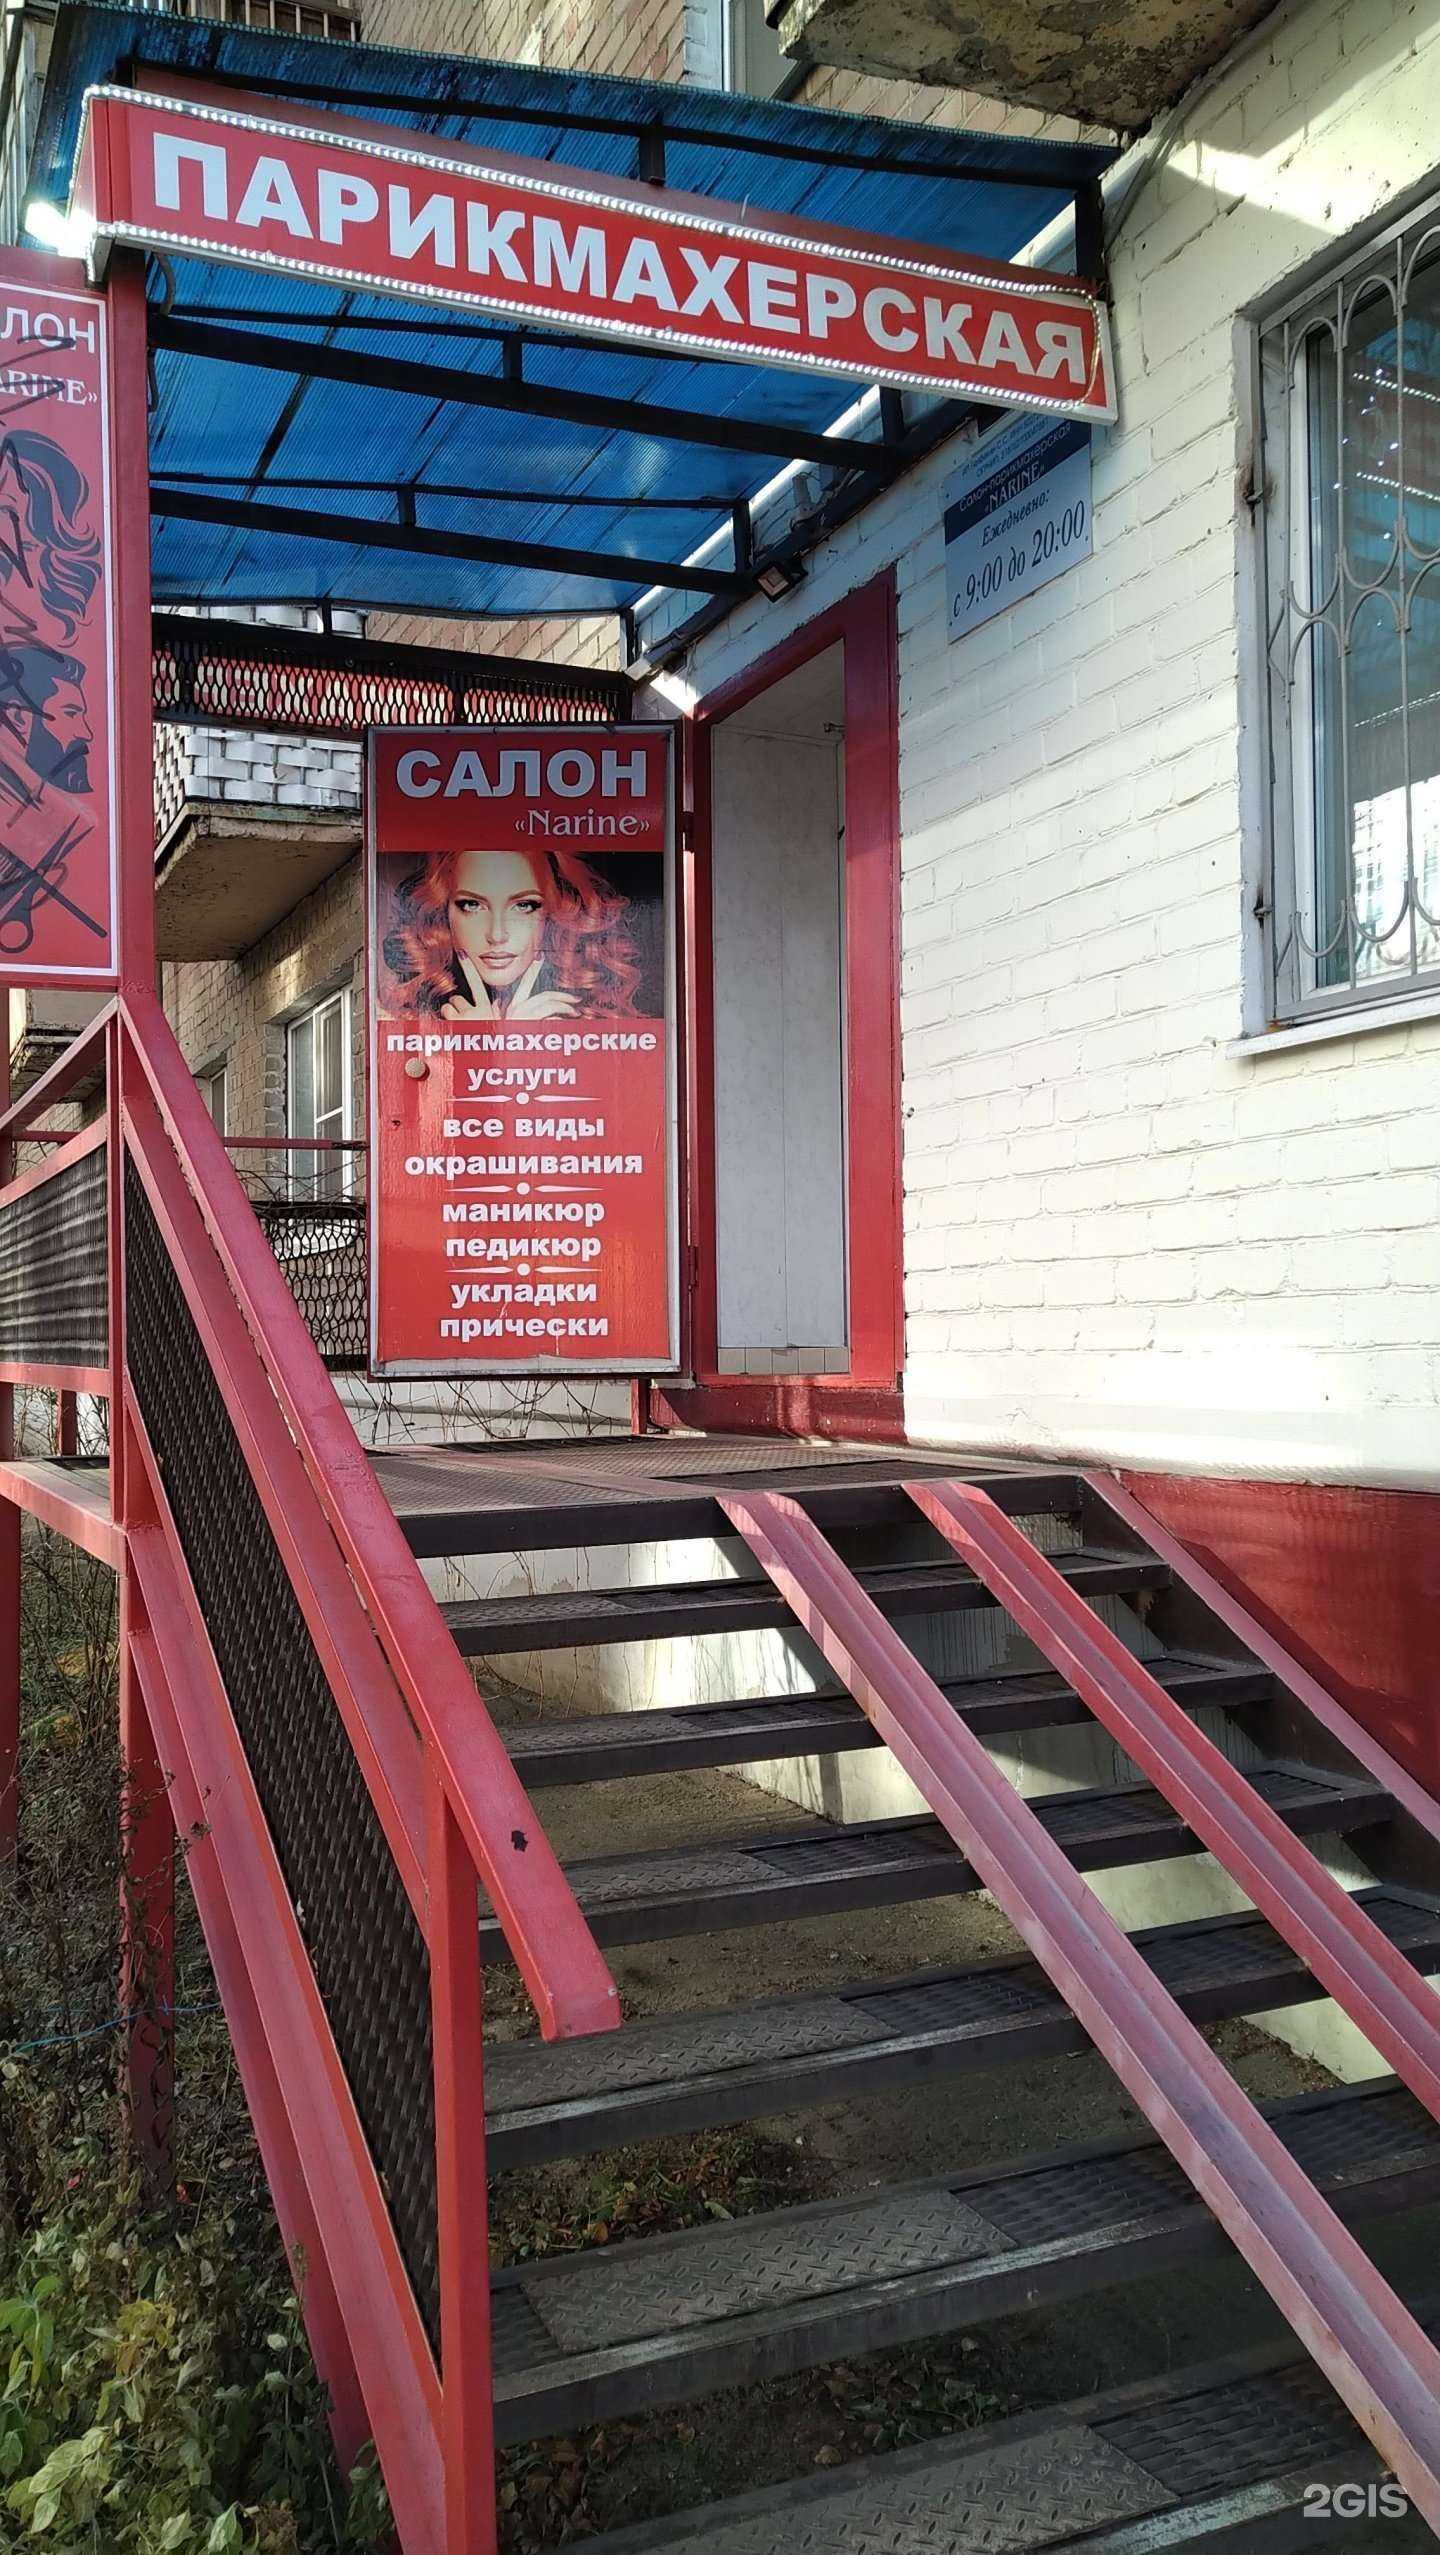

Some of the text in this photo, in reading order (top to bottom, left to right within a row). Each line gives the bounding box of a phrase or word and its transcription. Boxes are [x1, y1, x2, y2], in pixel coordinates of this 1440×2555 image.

[153, 132, 1086, 384] ПАРИКМАХЕРСКАЯ
[982, 489, 1050, 547] Ежедневно:
[966, 555, 1003, 611] 9:00
[1008, 546, 1026, 582] до
[1031, 500, 1085, 568] 20:00
[396, 749, 647, 798] САЛОН
[514, 808, 650, 836] «Narine»
[386, 1032, 657, 1056] парикмахерские
[466, 1067, 577, 1091] услуги
[442, 1118, 605, 1141] все виды
[404, 1155, 643, 1180] окрашивания
[442, 1202, 605, 1227] маникюр
[446, 1237, 602, 1261] педикюр
[450, 1283, 598, 1309] укладки
[440, 1317, 609, 1342] прически
